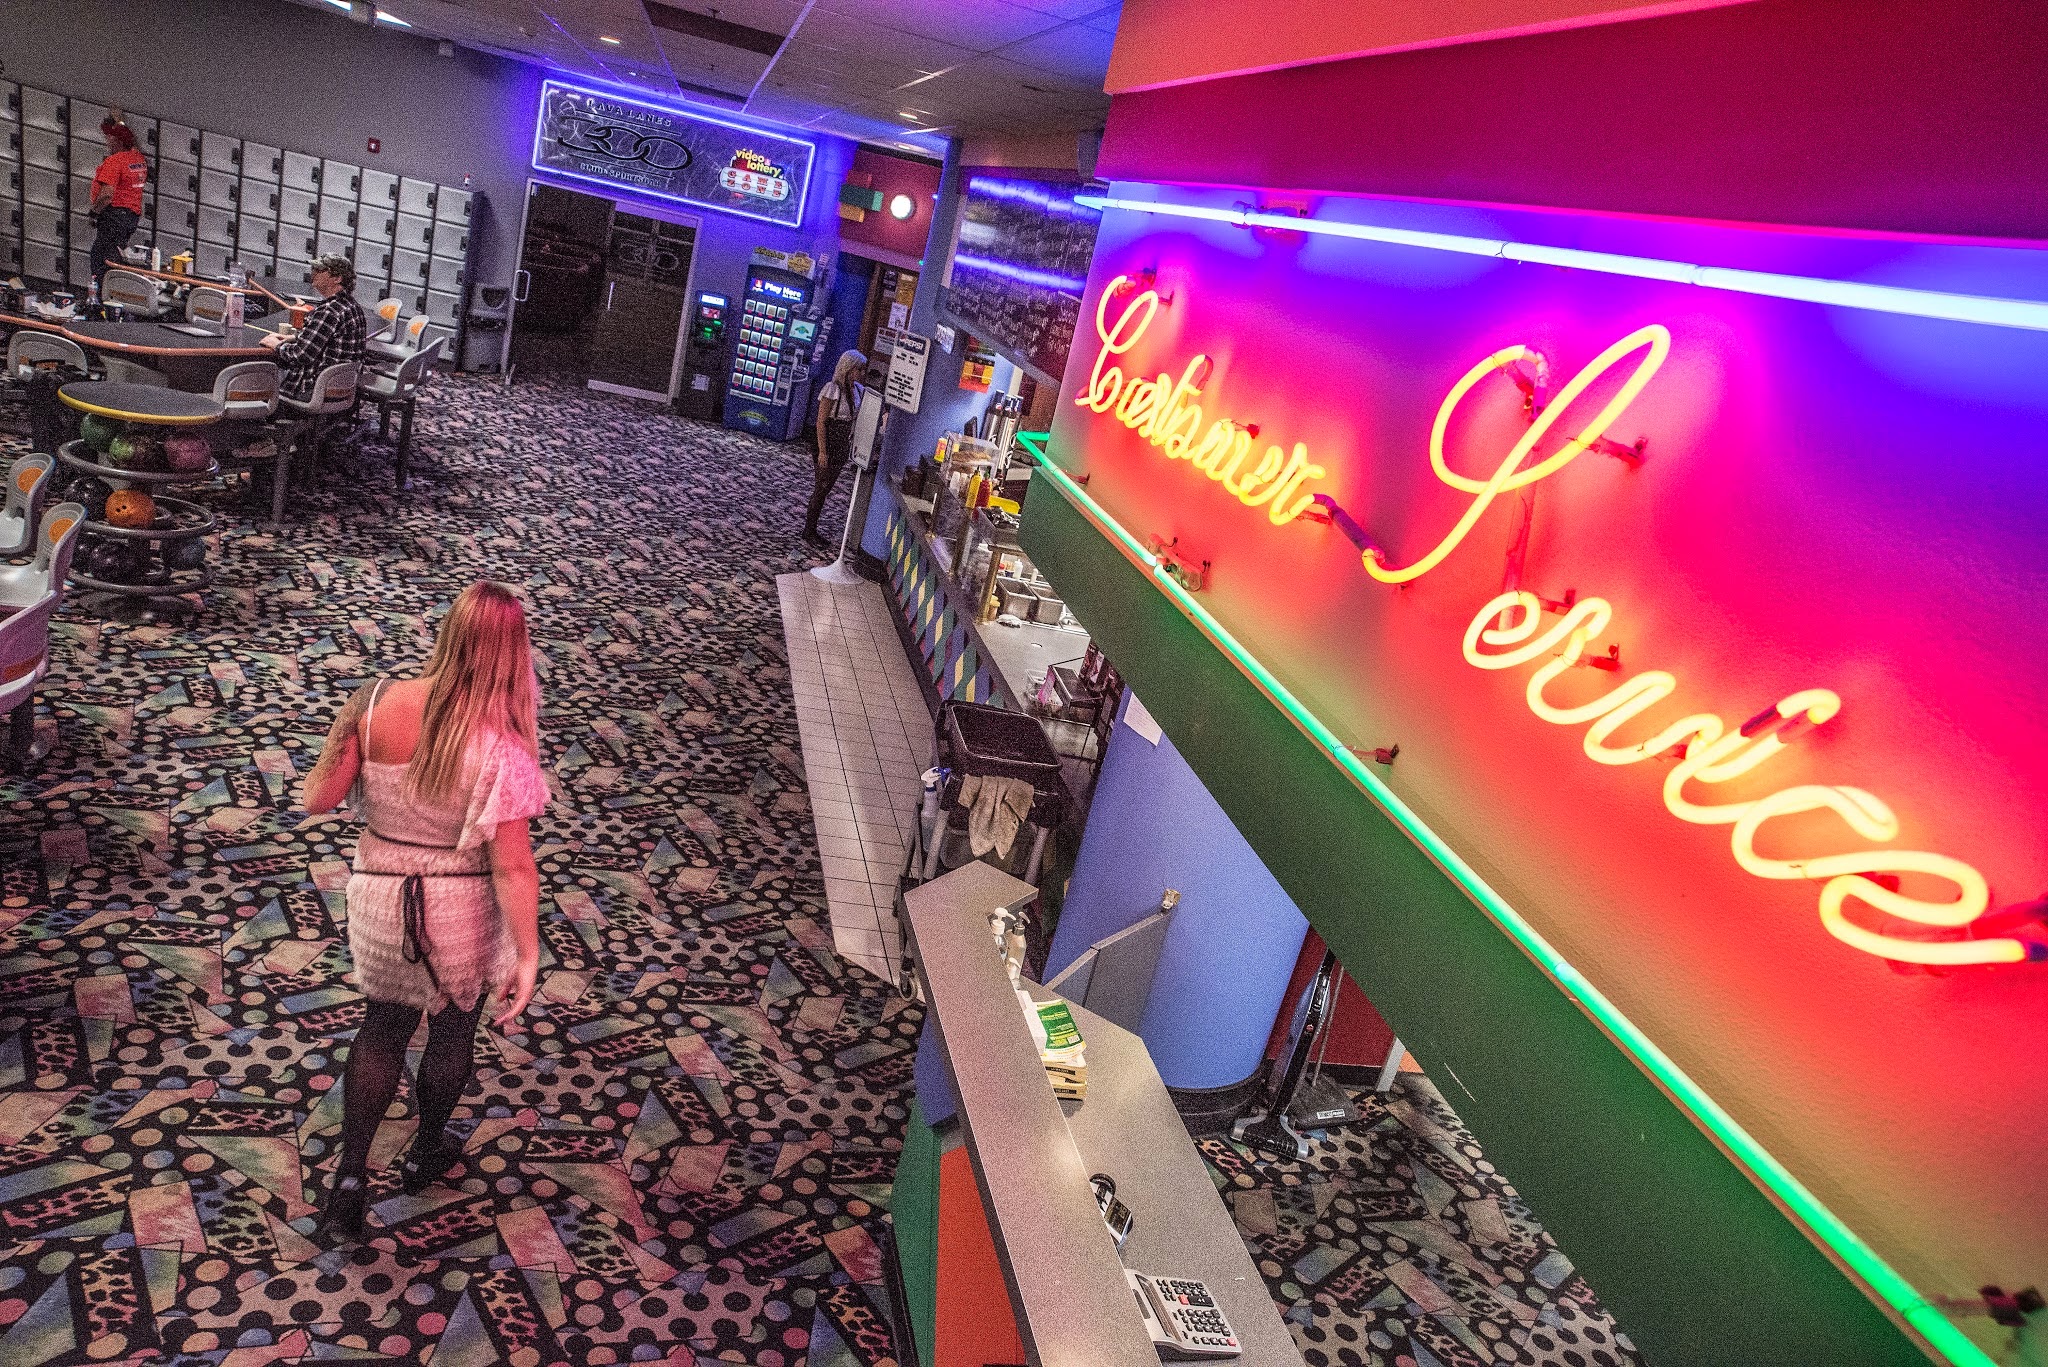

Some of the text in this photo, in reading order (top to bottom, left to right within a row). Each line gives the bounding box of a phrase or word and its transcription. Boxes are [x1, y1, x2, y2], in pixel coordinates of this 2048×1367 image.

[587, 98, 671, 127] LAVA LANES
[558, 115, 693, 170] 300
[735, 148, 765, 163] video
[746, 160, 782, 178] lottery
[727, 170, 783, 189] GAME
[727, 178, 781, 197] ZONE
[764, 281, 782, 295] Play
[782, 286, 802, 299] Here
[1075, 275, 2025, 966] Customer Service
